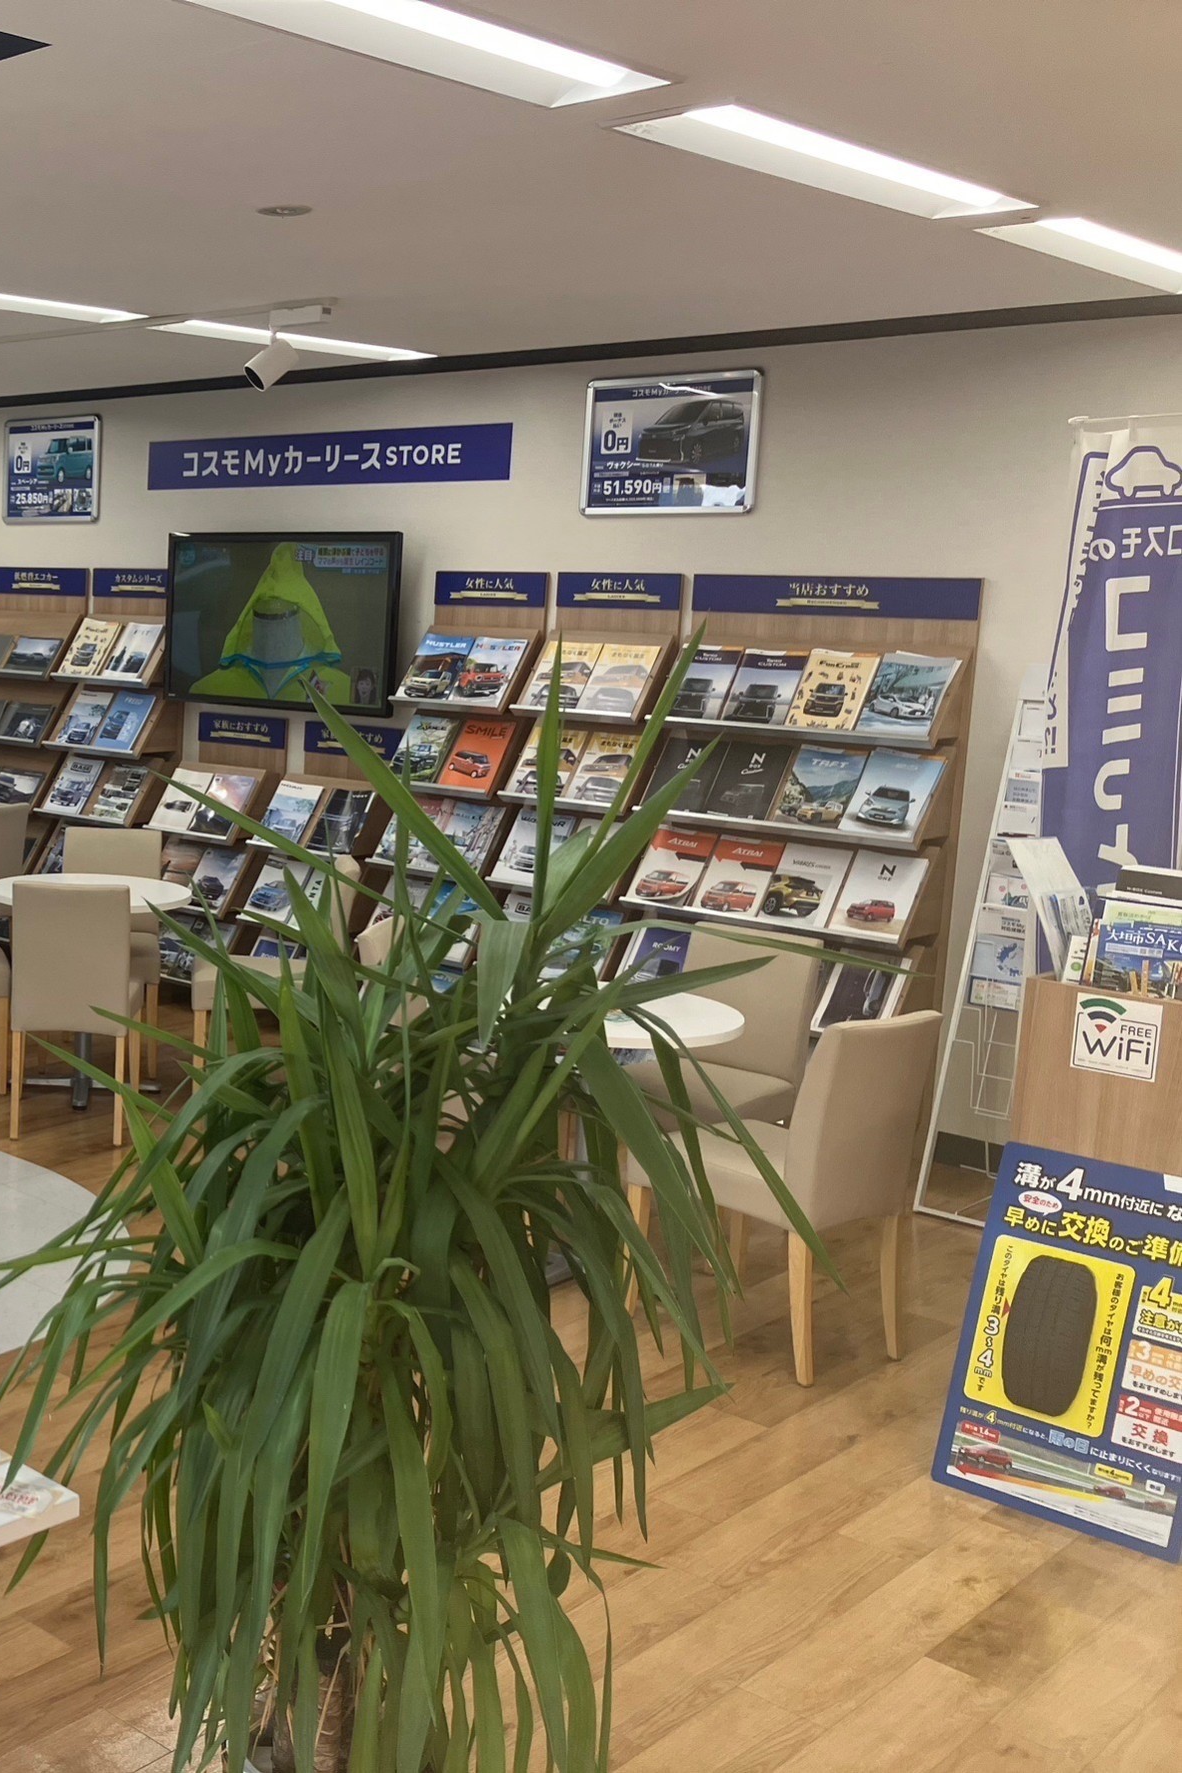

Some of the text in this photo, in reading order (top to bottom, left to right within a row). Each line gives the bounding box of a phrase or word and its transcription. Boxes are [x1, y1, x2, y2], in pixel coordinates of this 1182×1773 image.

[603, 430, 629, 452] 0円
[182, 442, 463, 478] コスモMyカーリースSTORE
[606, 461, 641, 469] ヴォクシー
[603, 479, 662, 495] 51,590円
[115, 573, 162, 584] カスタムシリーズ
[465, 577, 514, 590] 女性に人気
[591, 577, 646, 592] 女性に人気
[789, 582, 869, 597] 当店おすすめ
[425, 639, 467, 649] HUSTLER
[212, 718, 269, 733] 家族におすすめ
[811, 758, 850, 768] TAFT
[668, 837, 698, 849] ATRAI
[732, 847, 764, 858] ATRAI
[879, 863, 897, 877] N
[578, 914, 610, 926] LTO
[1105, 927, 1182, 955] 大垣市SAK
[1120, 1024, 1153, 1040] FREE
[1082, 1030, 1153, 1066] WiFi
[1023, 1194, 1059, 1209] 安全のため
[1148, 1275, 1175, 1310] 4
[1131, 1422, 1169, 1447] 交換
